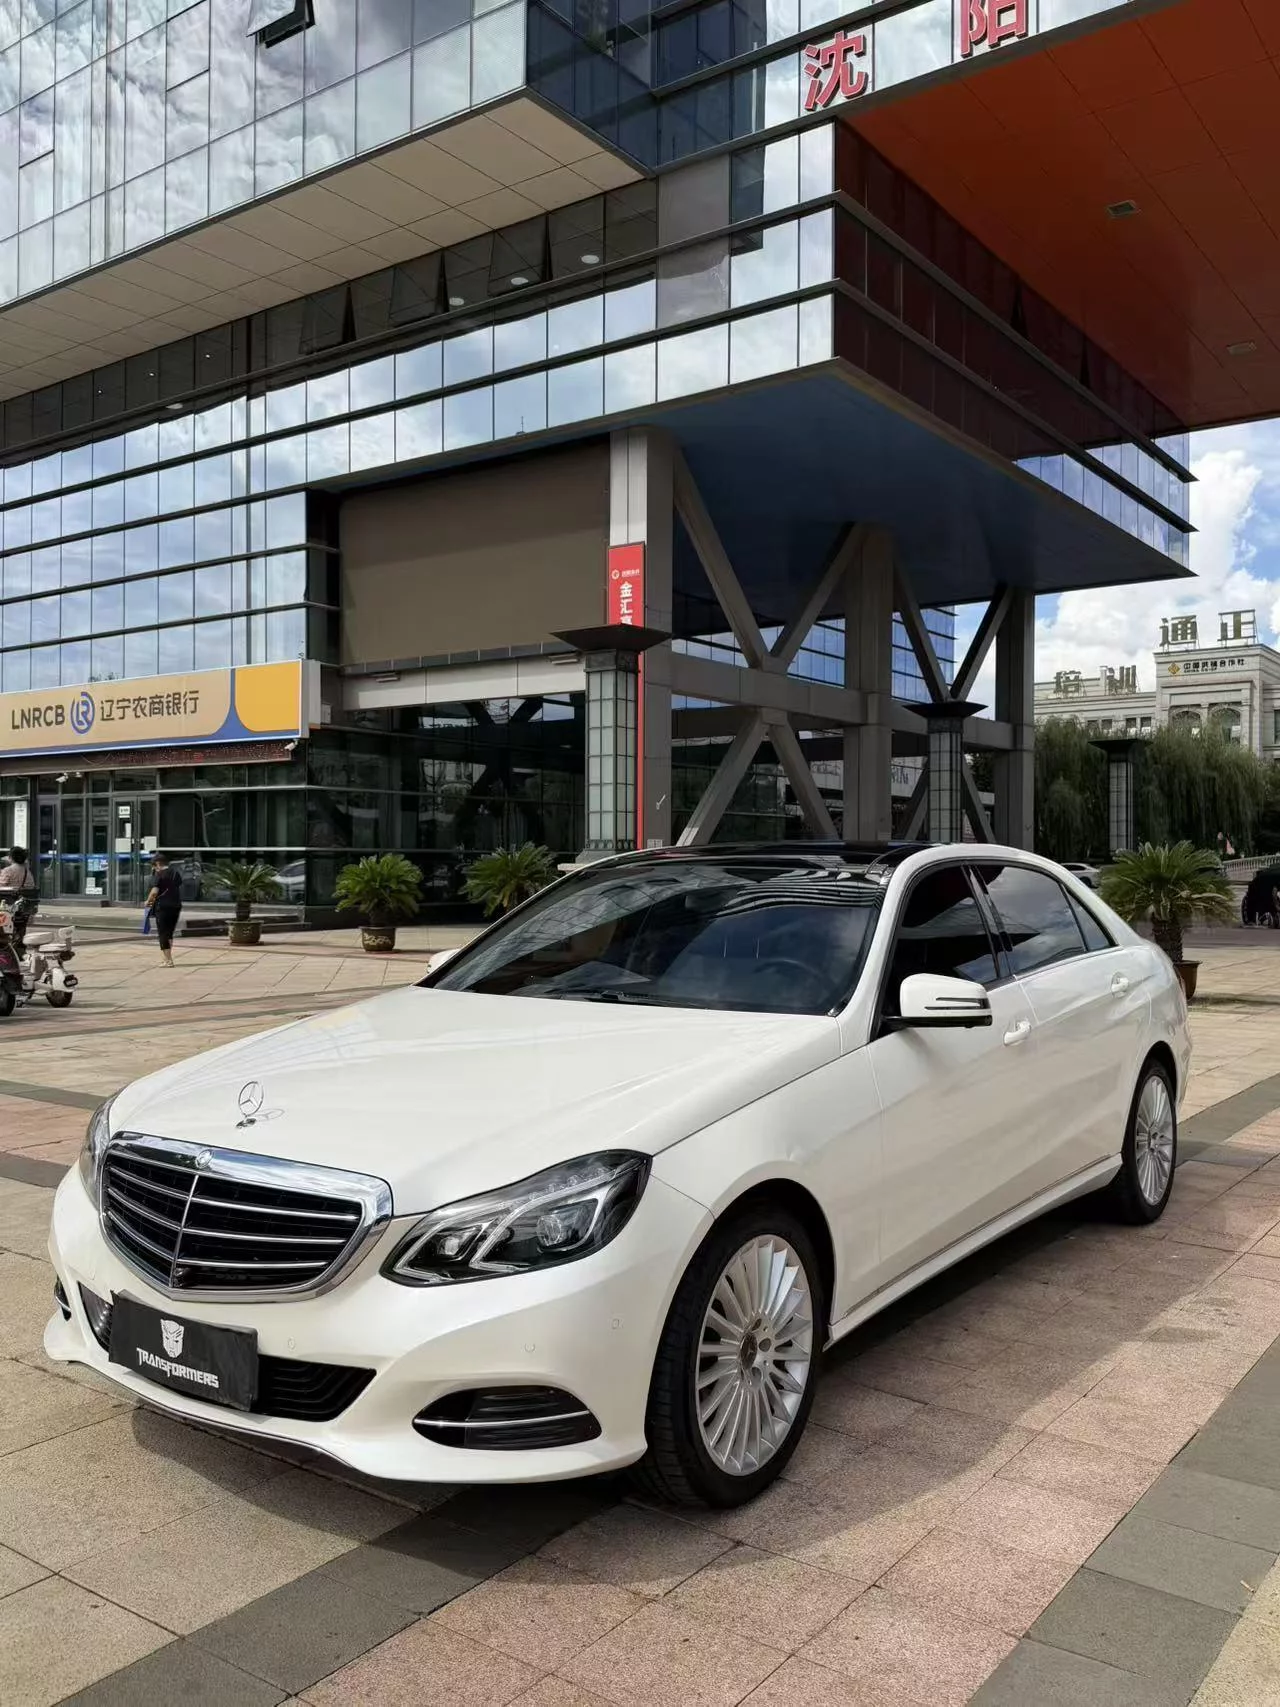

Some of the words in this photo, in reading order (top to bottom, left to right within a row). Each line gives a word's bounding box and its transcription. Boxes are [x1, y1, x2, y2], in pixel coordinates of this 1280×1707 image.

[11, 704, 65, 730] LNRCB
[100, 690, 199, 721] 辽宁农商银行
[136, 1347, 219, 1388] TRANSFORMERS
